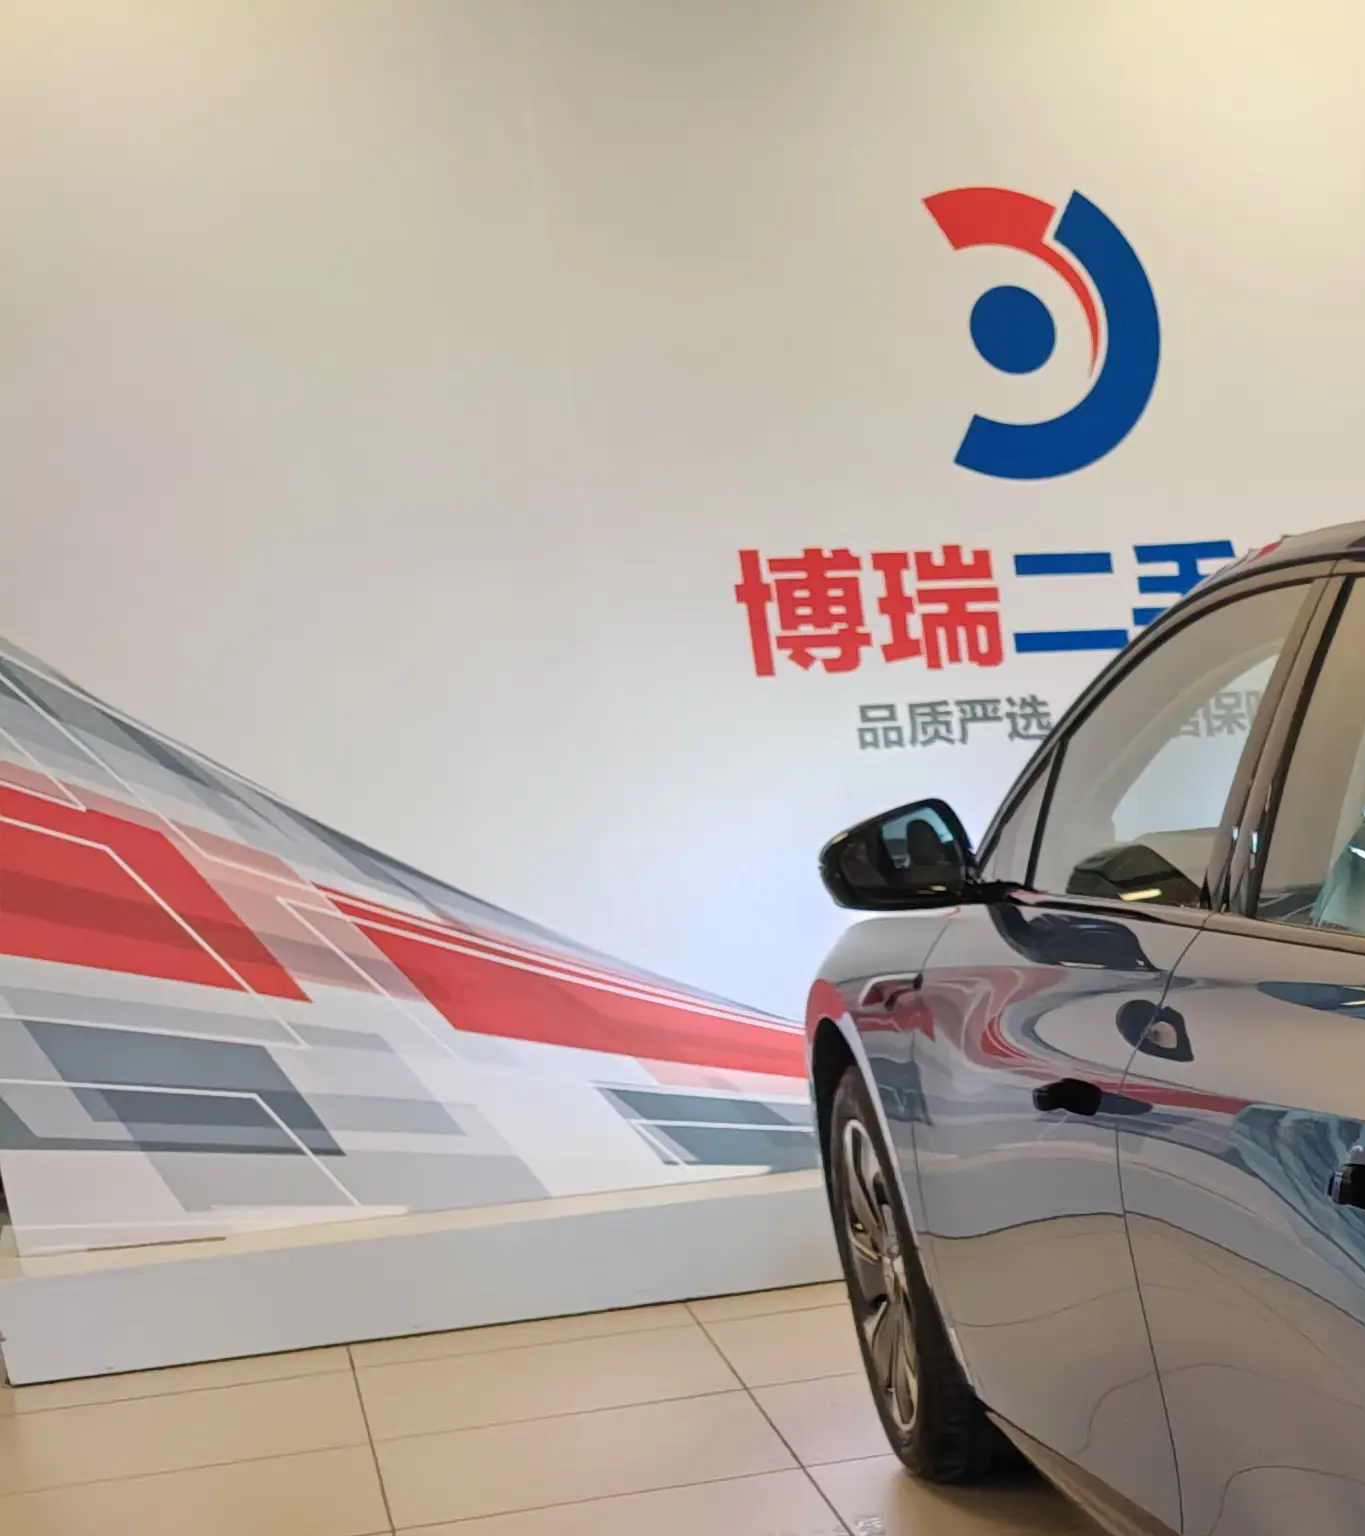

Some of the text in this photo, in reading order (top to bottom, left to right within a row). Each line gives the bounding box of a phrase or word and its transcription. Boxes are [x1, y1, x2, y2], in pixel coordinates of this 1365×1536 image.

[735, 540, 1283, 677] 博瑞二手
[857, 694, 1055, 748] 品质严选
